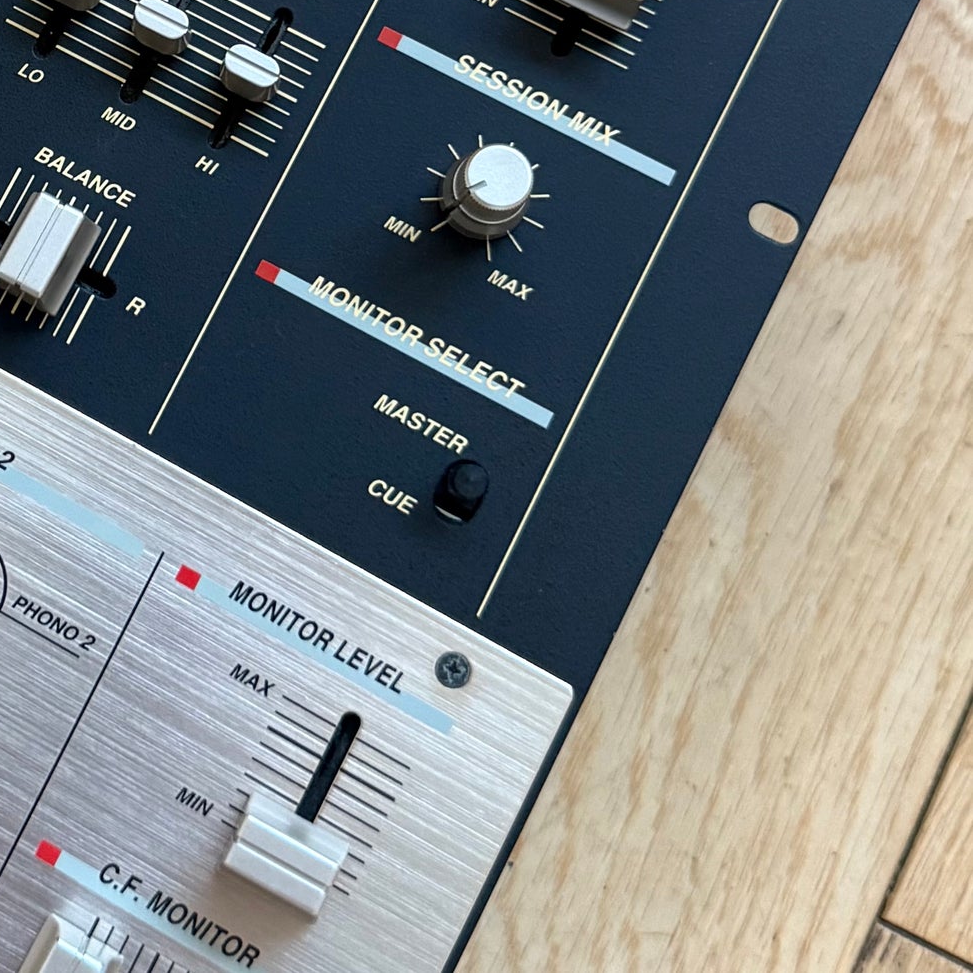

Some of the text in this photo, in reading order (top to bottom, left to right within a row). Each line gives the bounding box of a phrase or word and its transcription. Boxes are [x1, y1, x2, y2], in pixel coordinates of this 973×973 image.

[17, 63, 45, 84] LO
[454, 54, 621, 147] SESSION MIX
[100, 106, 137, 132] MID
[34, 146, 136, 209] BALANCE
[195, 155, 220, 176] HI
[383, 215, 422, 243] MIN
[487, 269, 535, 301] MAX
[126, 296, 147, 316] R
[308, 275, 526, 398] MONITOR SELECT
[373, 394, 469, 455] MASTER
[368, 479, 418, 515] CUE
[12, 595, 97, 652] PHONO 2
[228, 580, 405, 694] MONITOR LEVEL
[229, 663, 275, 697] MAX
[174, 787, 215, 816] MIN
[99, 863, 261, 969] C.F. MONITOR
